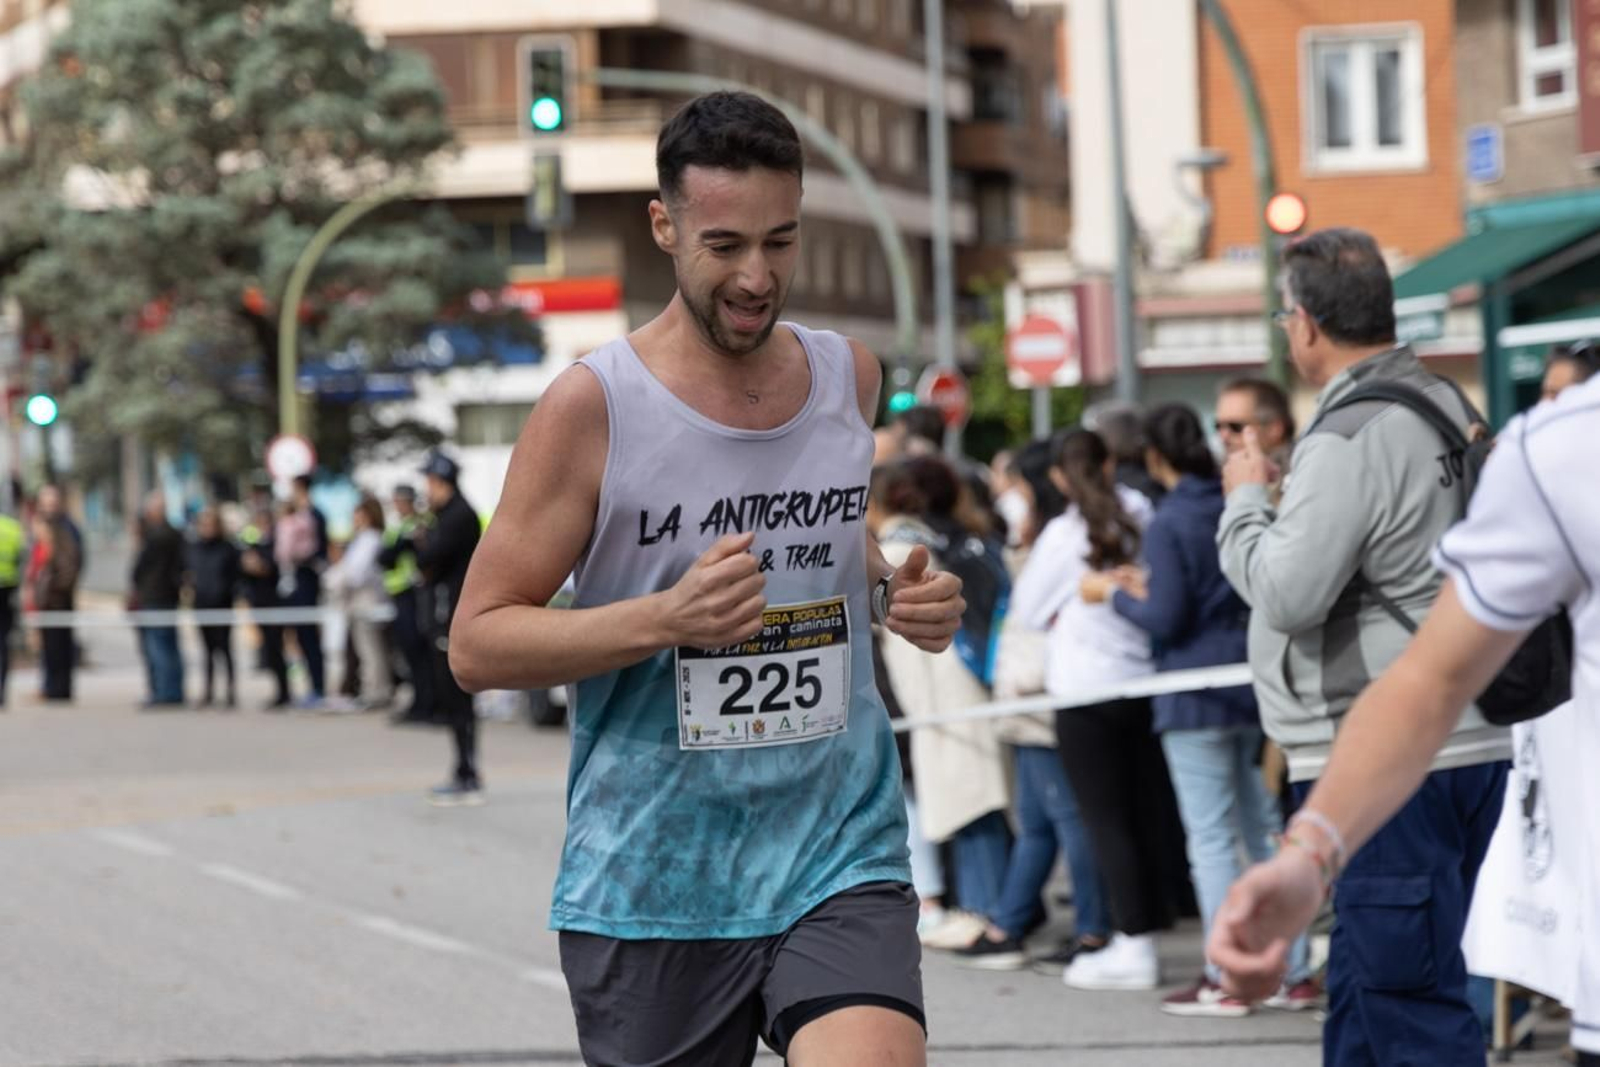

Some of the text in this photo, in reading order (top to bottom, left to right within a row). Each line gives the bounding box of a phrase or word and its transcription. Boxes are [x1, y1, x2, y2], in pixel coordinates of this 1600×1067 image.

[1435, 450, 1464, 488] JO
[638, 504, 681, 546] LA
[758, 542, 835, 573] & TRAIL
[763, 612, 791, 626] ERA
[789, 616, 842, 633] caminata
[718, 657, 822, 716] 225
